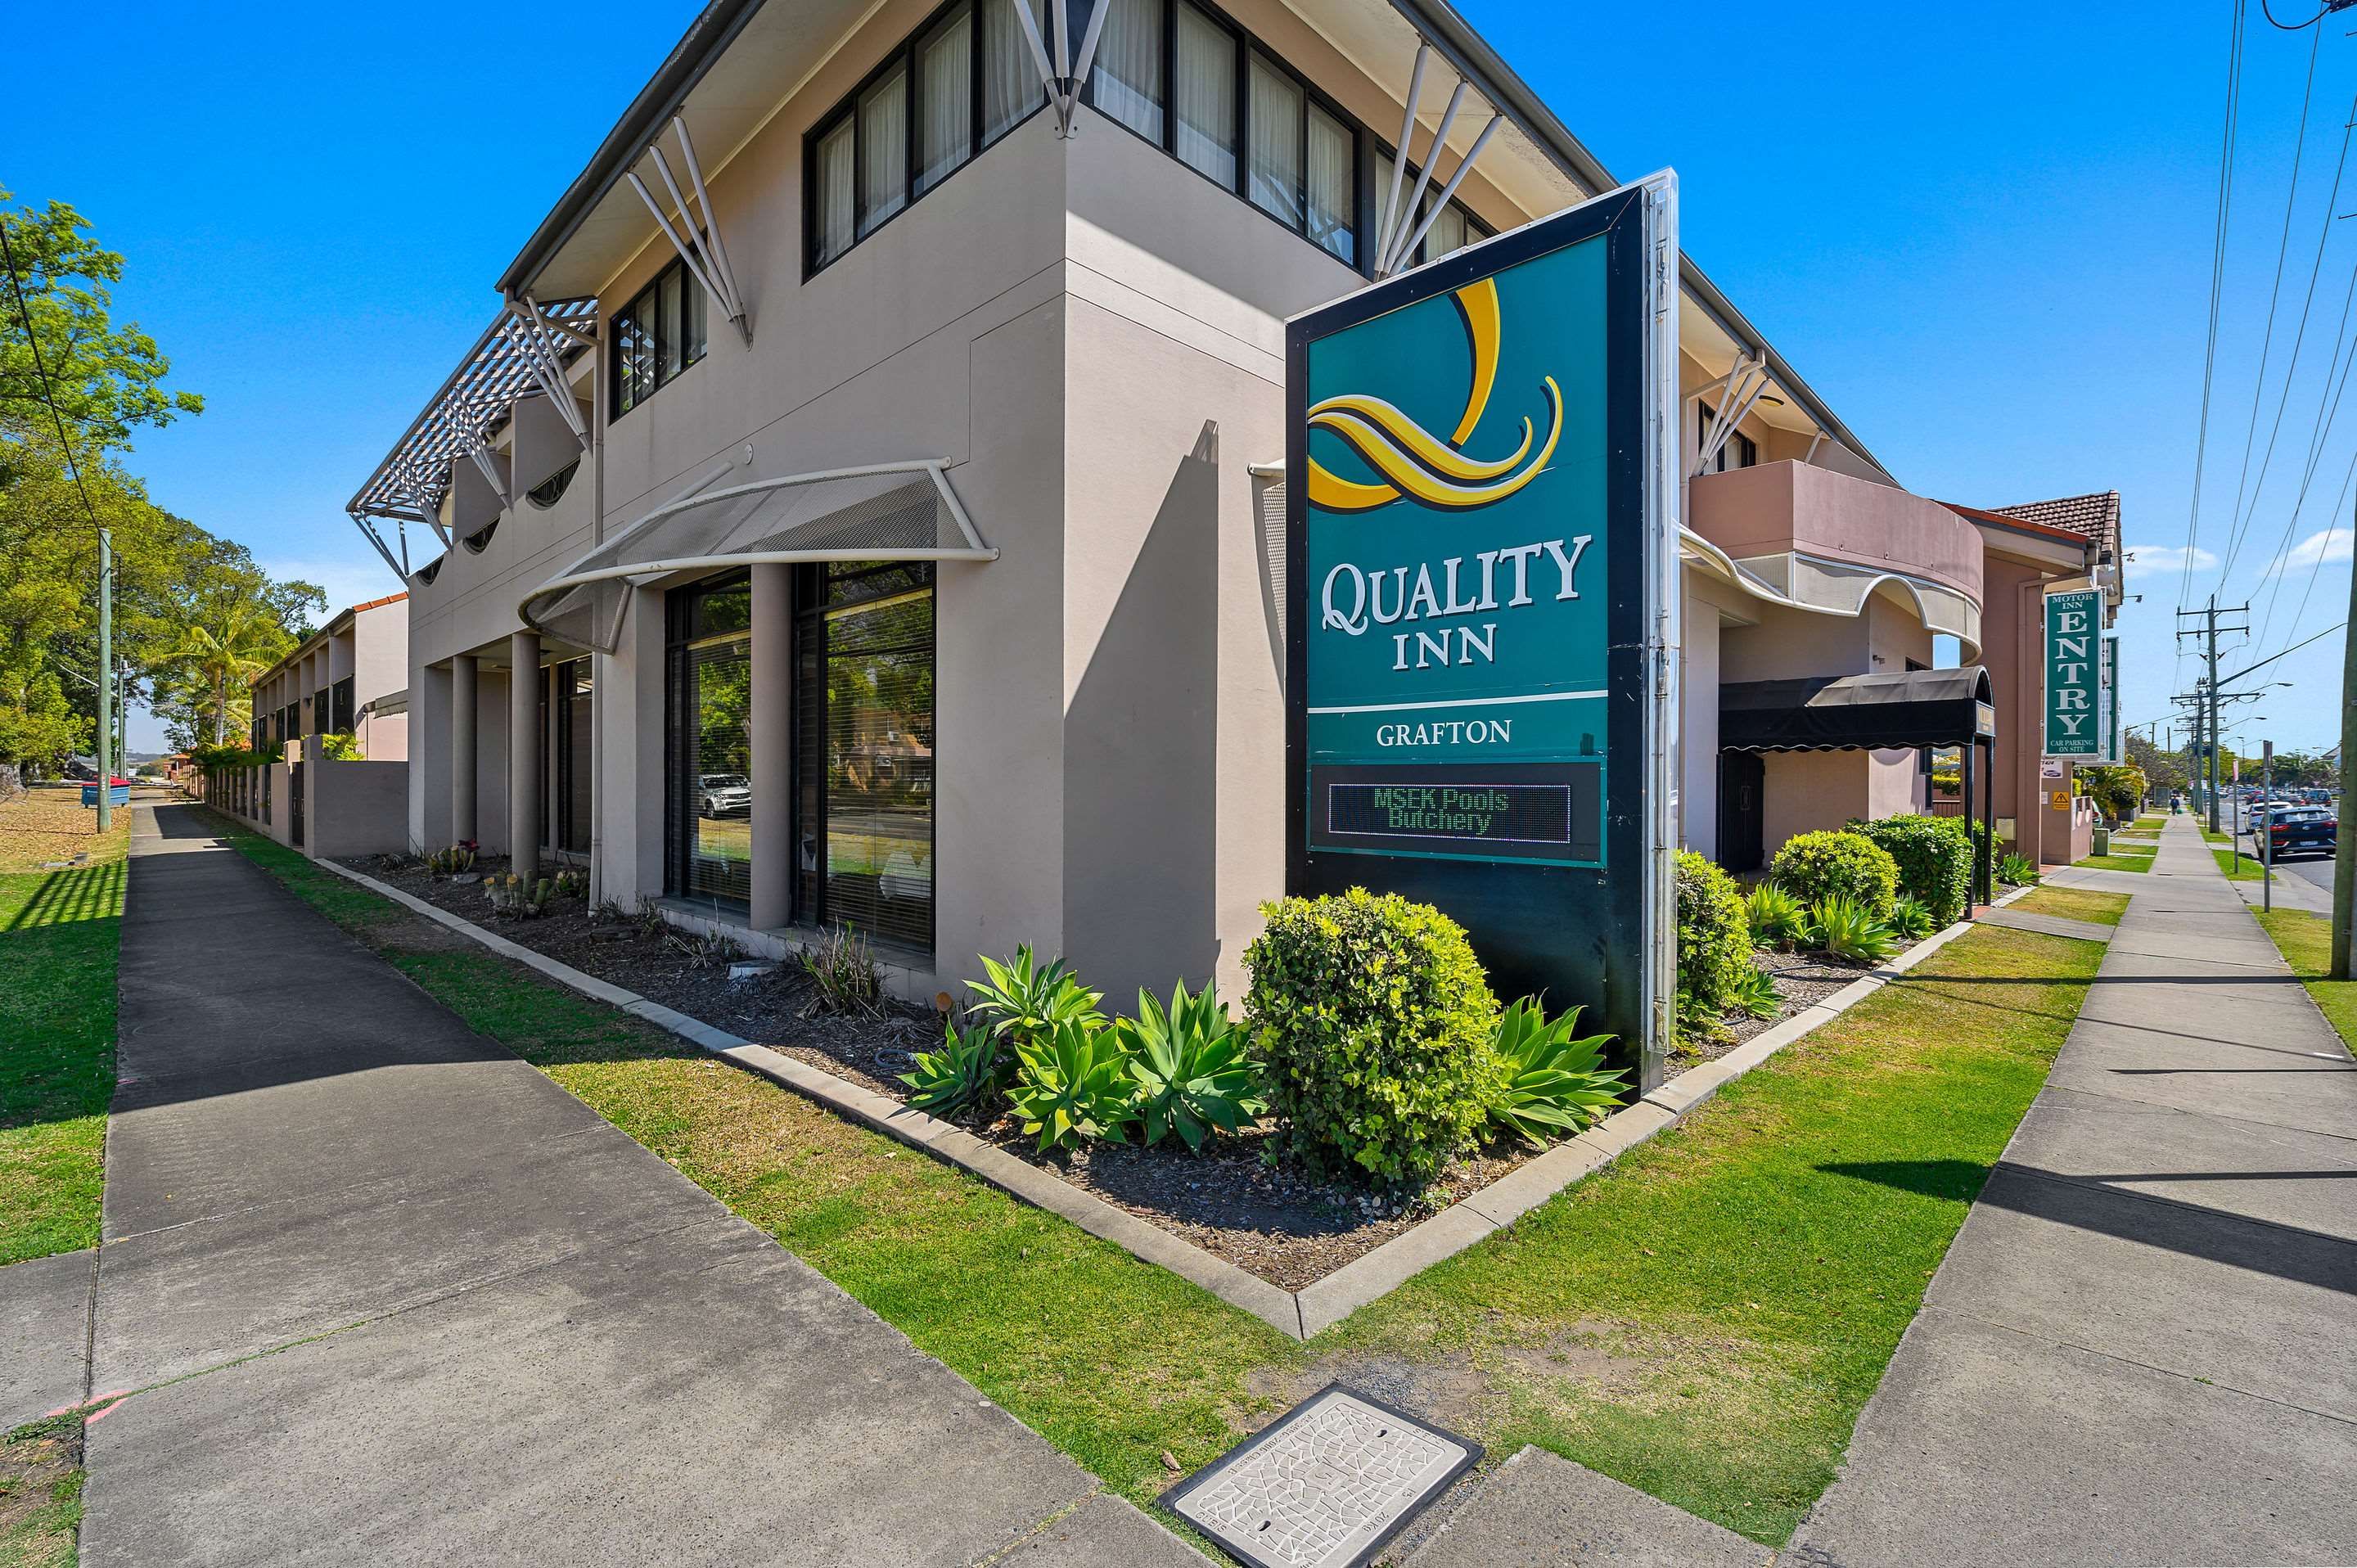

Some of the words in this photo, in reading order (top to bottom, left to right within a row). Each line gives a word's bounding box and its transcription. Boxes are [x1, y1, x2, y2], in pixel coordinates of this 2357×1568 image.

[1322, 534, 1592, 636] QUALITY
[2053, 593, 2093, 603] MOTOR
[2062, 602, 2083, 610] INN
[1392, 624, 1497, 670] INN
[2055, 611, 2090, 735] ENTRY
[1377, 719, 1512, 746] GRAFTON
[1374, 788, 1435, 809] MSEK
[1443, 789, 1508, 811] Pools
[1389, 807, 1492, 836] Butchery
[1195, 1512, 1227, 1533] CUBIS
